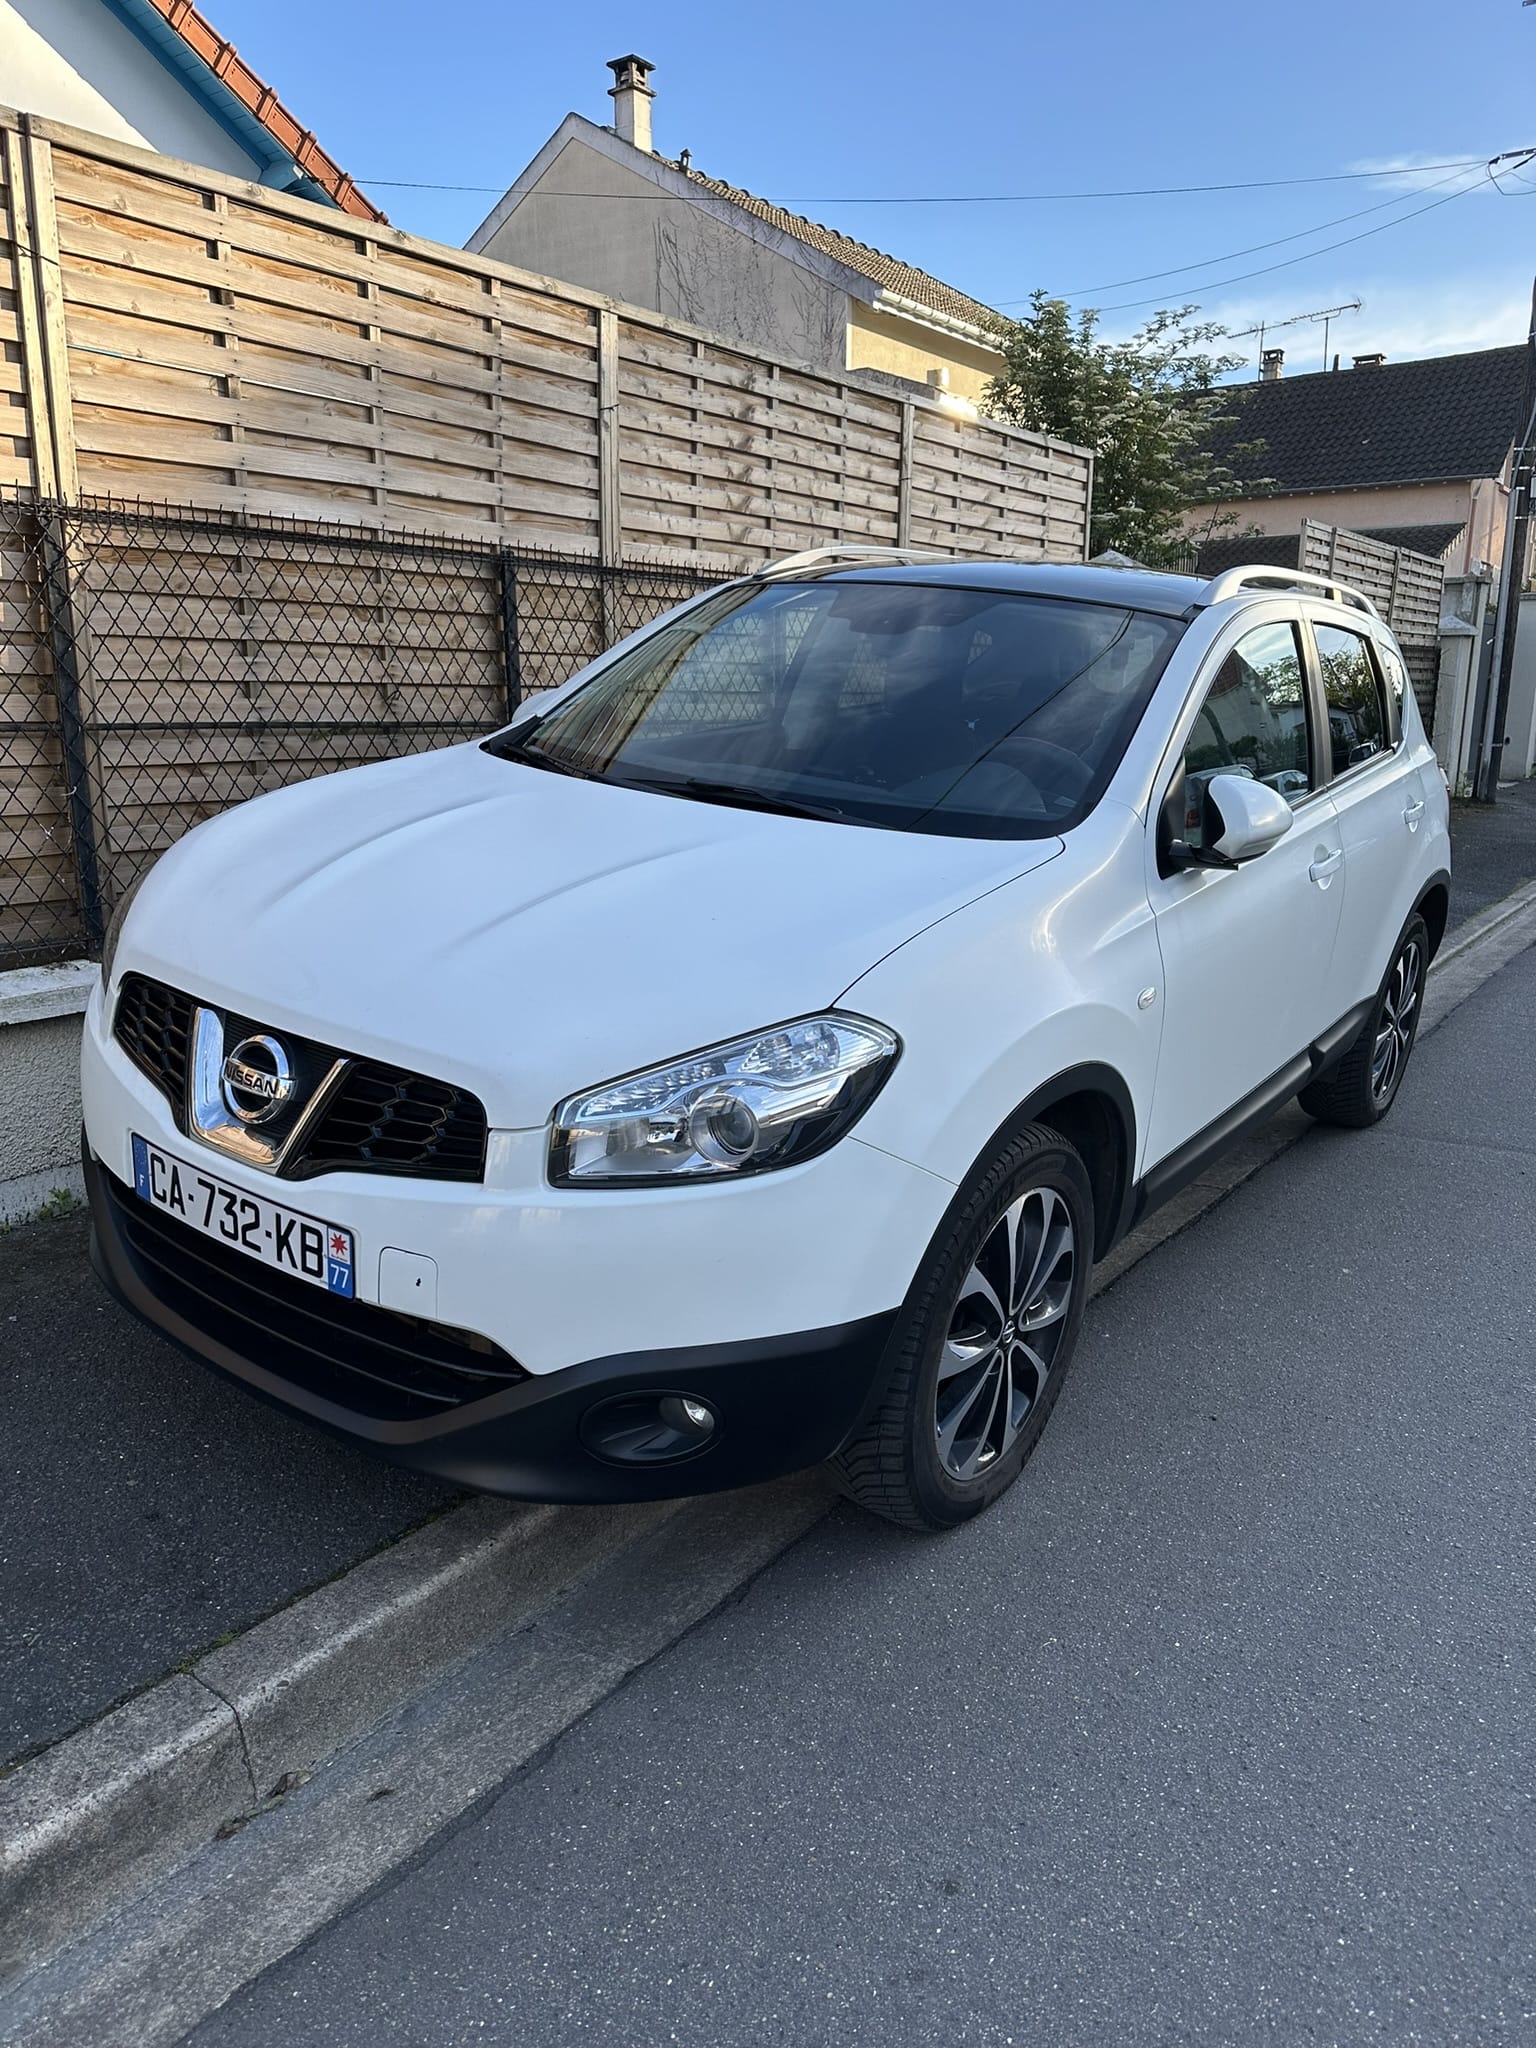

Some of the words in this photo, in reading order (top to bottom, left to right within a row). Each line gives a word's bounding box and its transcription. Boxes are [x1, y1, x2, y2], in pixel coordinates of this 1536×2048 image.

[224, 1062, 279, 1096] NISSAN
[139, 1173, 145, 1187] F
[150, 1152, 323, 1279] CA-732-KB
[330, 1263, 349, 1289] 77
